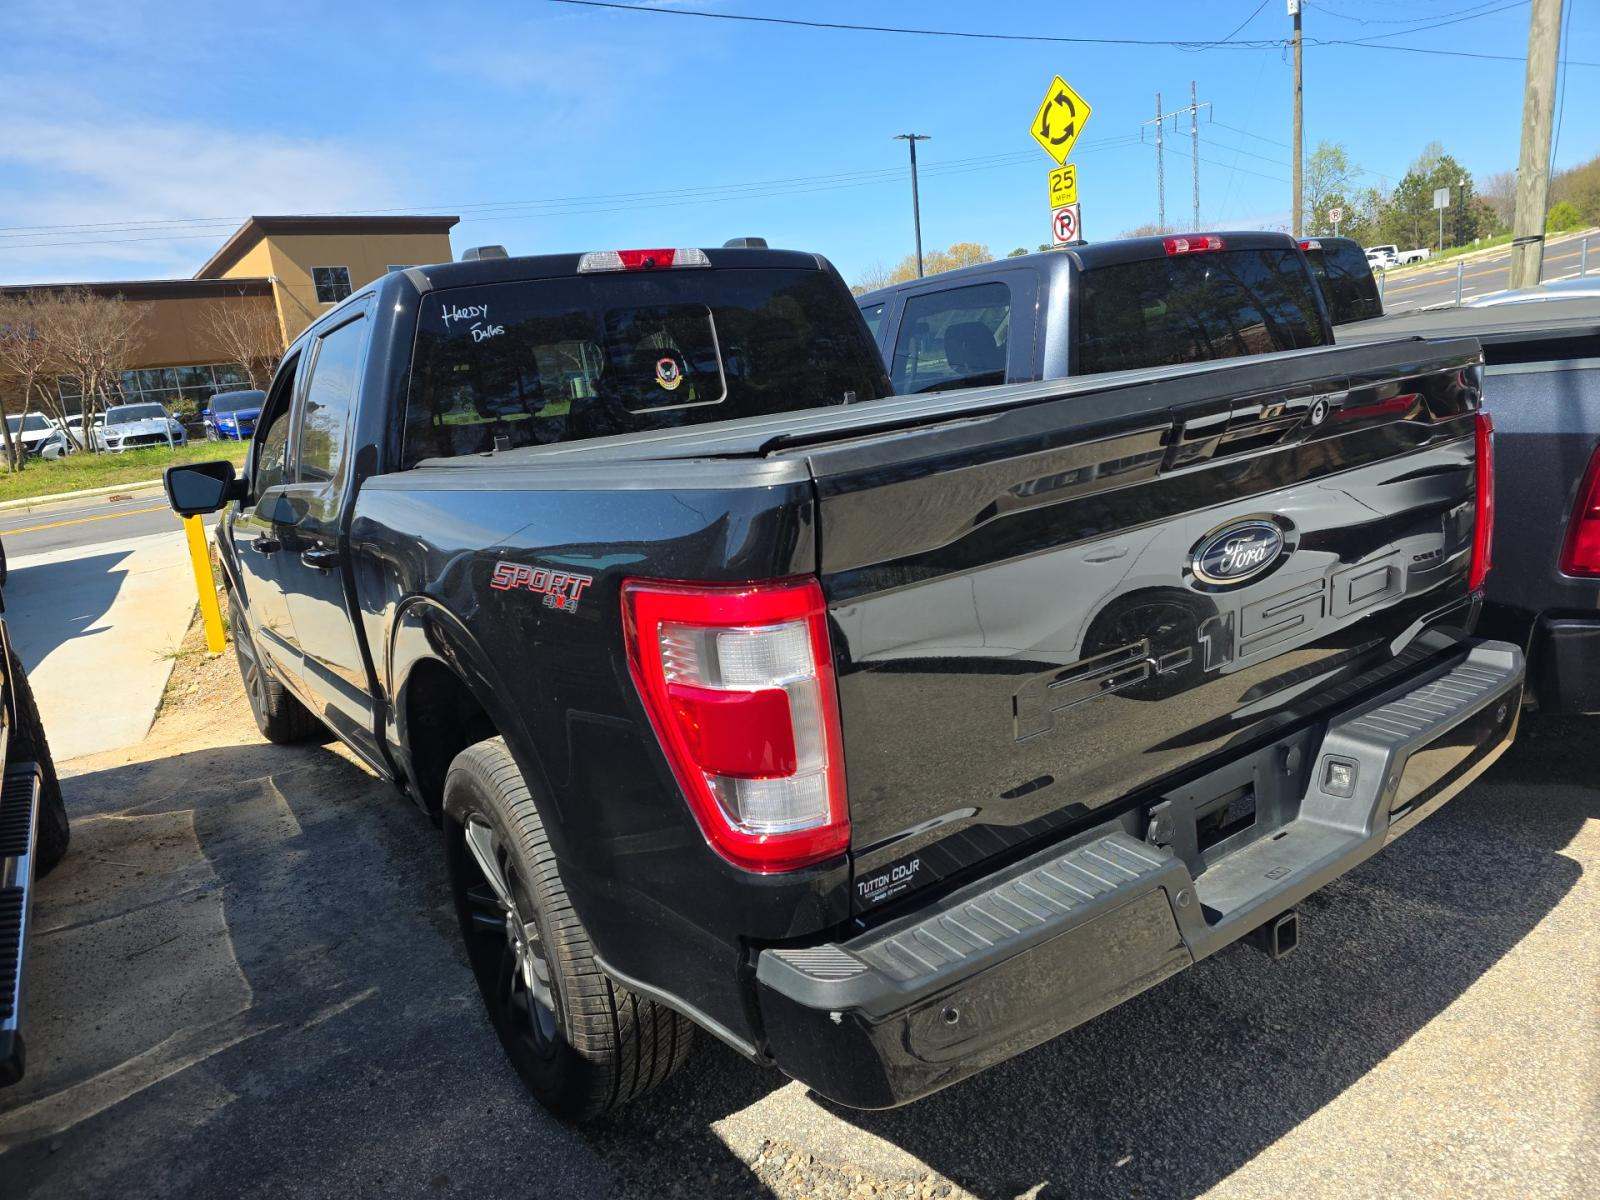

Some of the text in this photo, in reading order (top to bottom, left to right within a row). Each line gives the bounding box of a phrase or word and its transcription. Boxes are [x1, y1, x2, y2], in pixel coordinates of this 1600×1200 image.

[1052, 170, 1074, 193] 25
[1056, 193, 1072, 202] MPH
[1061, 215, 1072, 236] P
[1220, 534, 1269, 573] Ford
[490, 560, 593, 600] SPORT
[1012, 549, 1408, 744] F-150
[892, 859, 920, 881] CDJR
